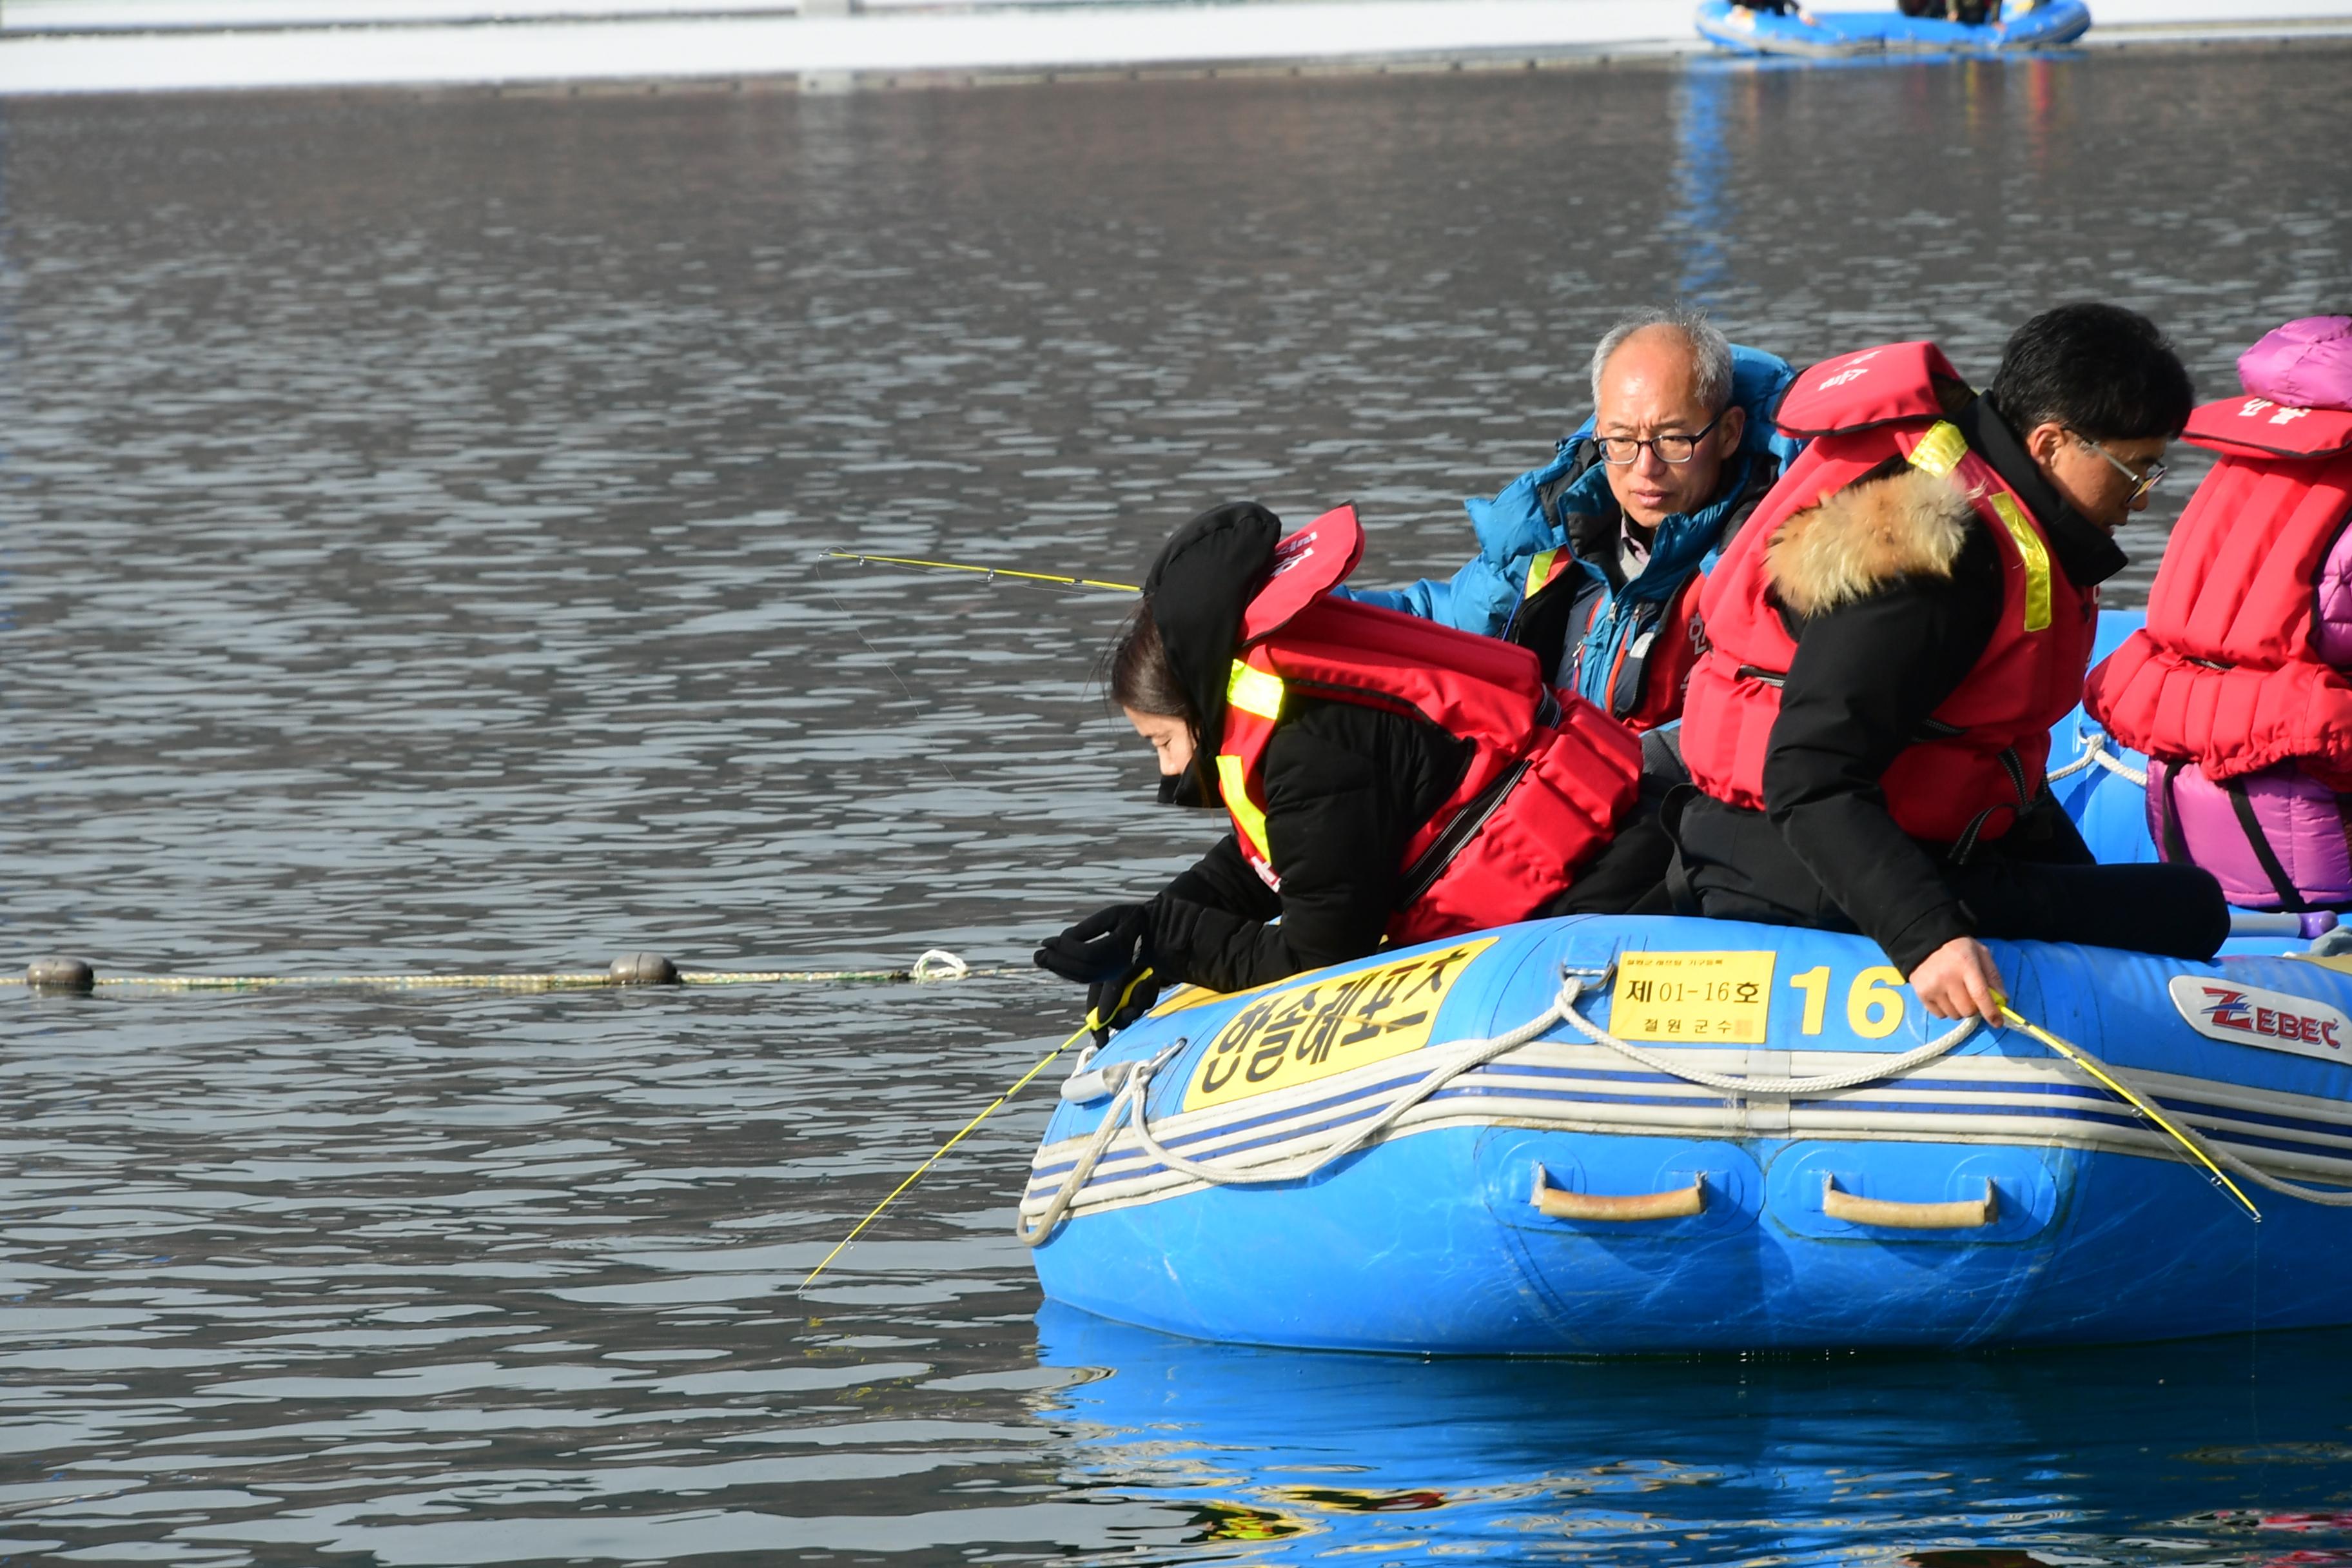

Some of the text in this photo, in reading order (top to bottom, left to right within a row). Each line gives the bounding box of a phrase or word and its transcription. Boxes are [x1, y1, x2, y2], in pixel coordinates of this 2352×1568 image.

[1202, 947, 1469, 1093] 한솔레포츠
[1790, 966, 1906, 1039] 16
[2200, 986, 2341, 1050] ZEBEC
